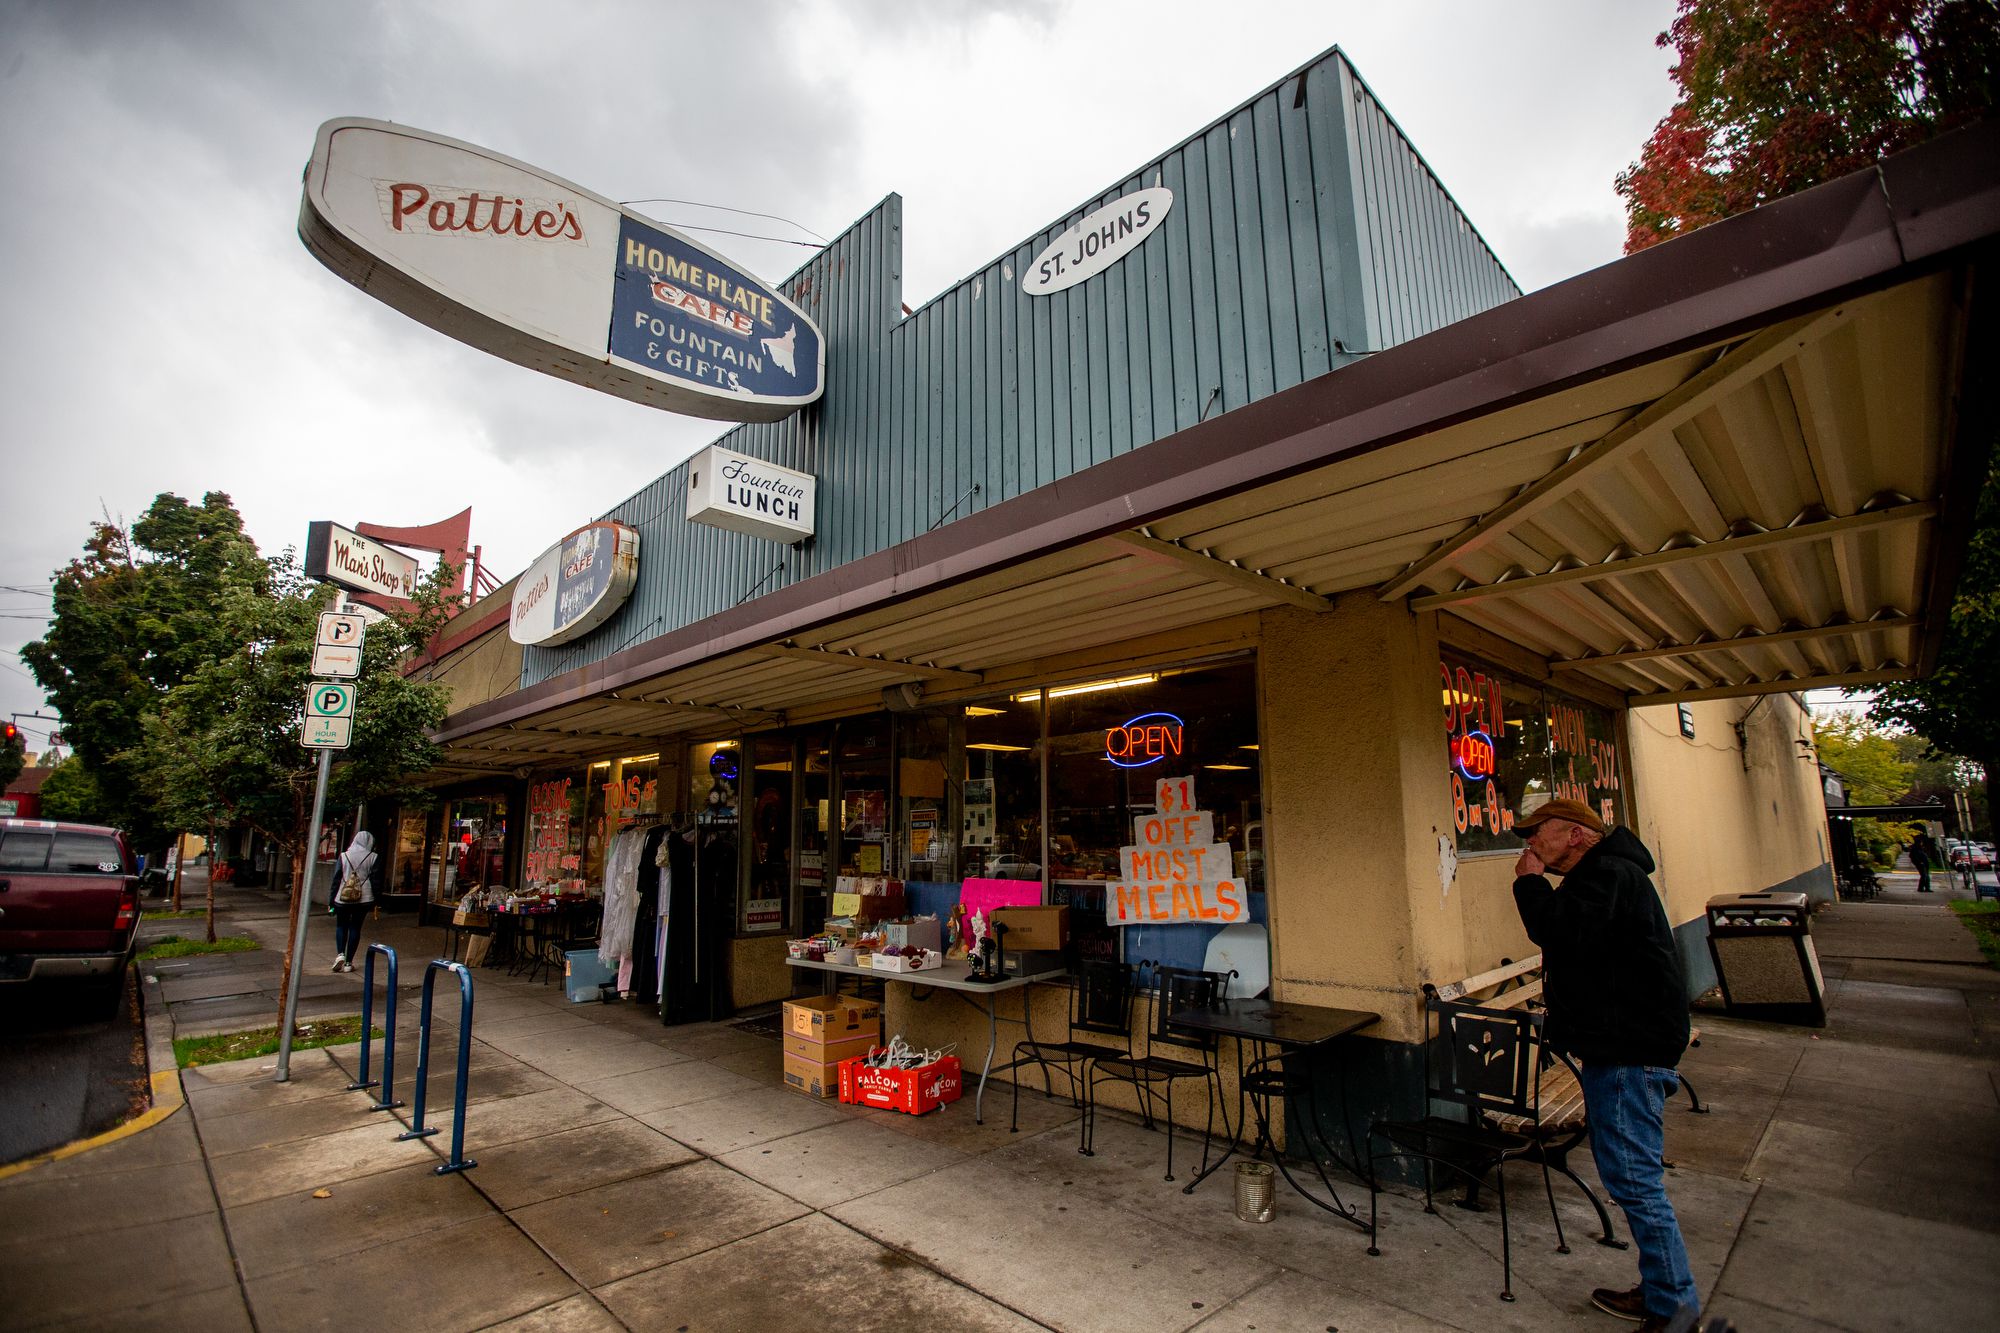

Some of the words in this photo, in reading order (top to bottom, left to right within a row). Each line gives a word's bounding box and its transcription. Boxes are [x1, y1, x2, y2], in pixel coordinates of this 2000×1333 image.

[389, 183, 583, 241] Pattie's
[1039, 251, 1066, 285] ST.
[1072, 200, 1151, 266] JOHNS
[651, 280, 754, 335] CAFE
[634, 311, 763, 374] FOUNTAIN
[647, 342, 661, 360] &
[665, 349, 741, 390] GIFTS
[722, 460, 804, 499] Fountain
[727, 484, 799, 521] LUNCH
[352, 537, 366, 550] THE
[335, 539, 369, 579] Man's
[371, 554, 400, 594] Shop
[565, 553, 594, 580] CAFE
[323, 692, 340, 710] P
[315, 730, 338, 738] HOUR
[323, 720, 330, 731] 1
[1106, 726, 1184, 756] OPEN
[1460, 734, 1494, 775] OPEN
[531, 777, 572, 815] CLOSING
[602, 775, 641, 813] TONS
[643, 778, 658, 801] OF
[1160, 780, 1191, 812] $1
[1145, 815, 1201, 846] OFF
[1131, 849, 1207, 882] MOST
[1116, 881, 1240, 922] MEALS
[857, 1074, 899, 1089] FALCON
